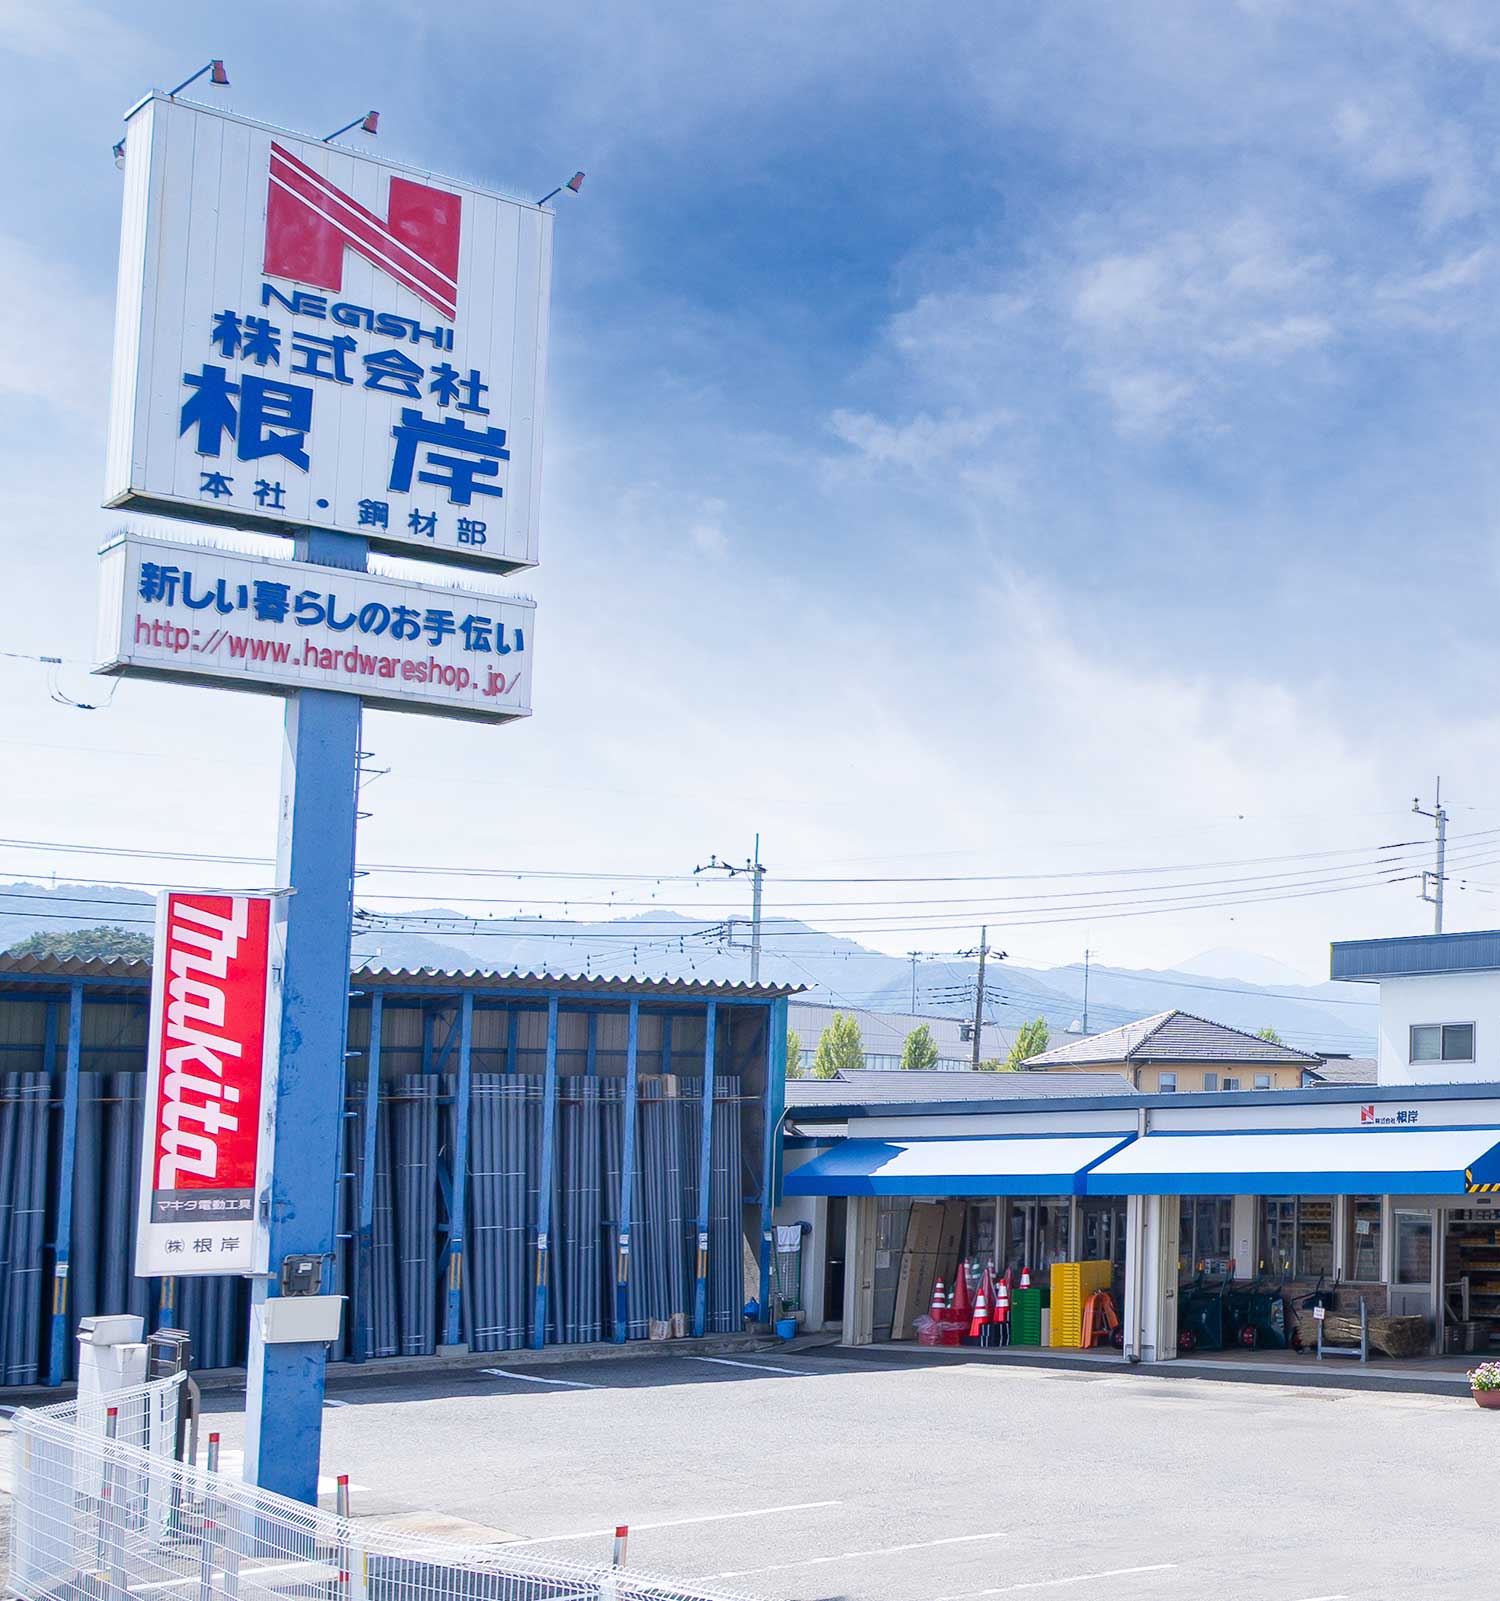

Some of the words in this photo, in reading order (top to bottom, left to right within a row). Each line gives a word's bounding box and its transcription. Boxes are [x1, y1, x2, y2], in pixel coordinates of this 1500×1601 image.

[211, 309, 490, 416] 株式会社
[262, 283, 454, 351] NEGISHI
[179, 363, 510, 506] 根岸
[135, 614, 522, 697] http://www.hardwareshop.jp/
[137, 561, 525, 656] 新しい暮らしのお手伝い
[158, 897, 249, 1190] makita
[157, 1199, 250, 1211] マキタ電動工具
